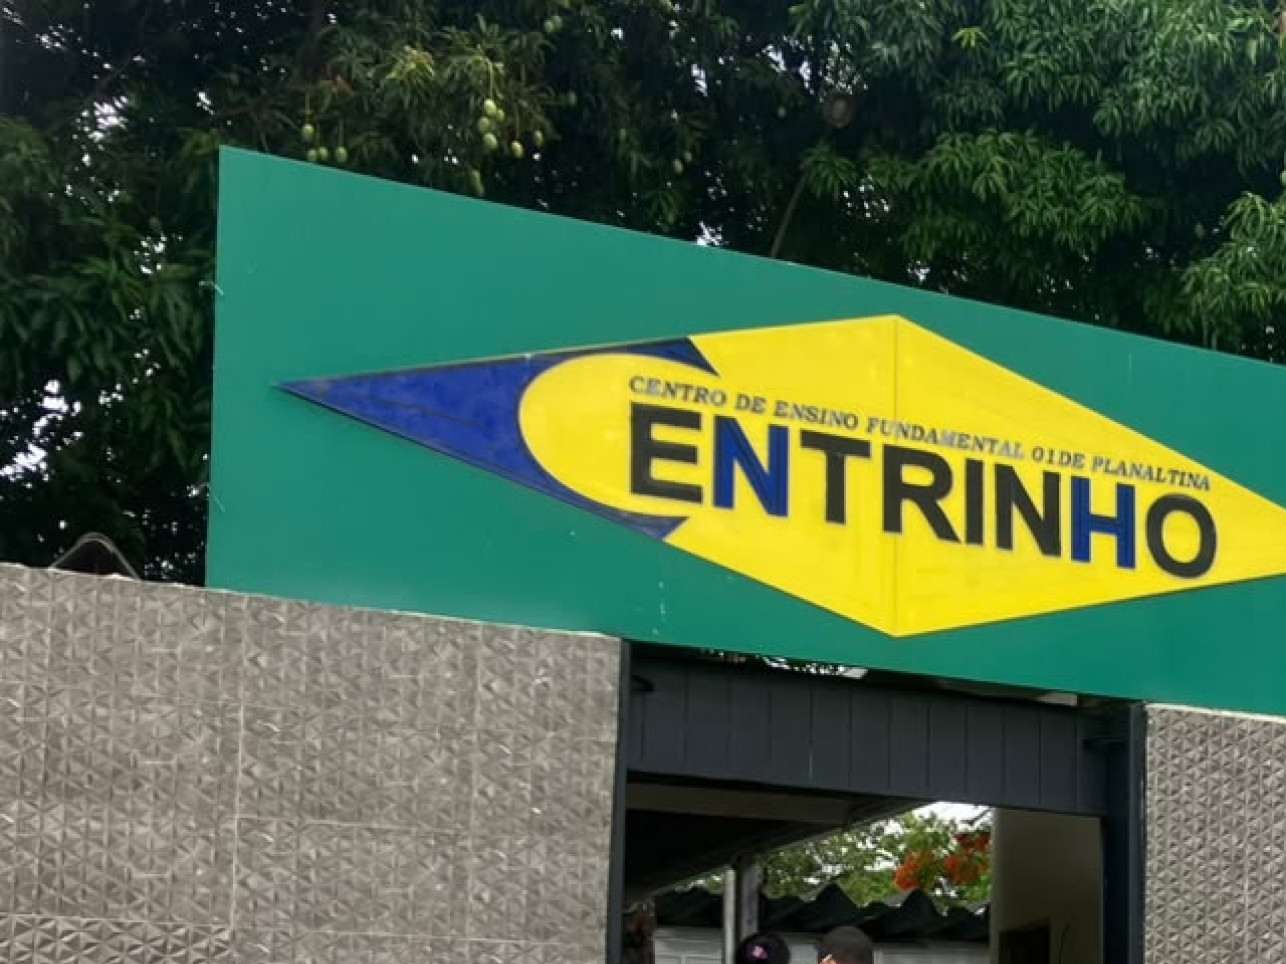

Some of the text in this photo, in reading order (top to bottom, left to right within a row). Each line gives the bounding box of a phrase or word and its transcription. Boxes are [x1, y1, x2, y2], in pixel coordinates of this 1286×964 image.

[629, 375, 727, 406] CENTRO
[735, 392, 767, 415] DE
[774, 400, 859, 430] ENSINO
[867, 416, 1024, 461] FUNDAMENTAL
[1092, 456, 1211, 491] PLANALTINA
